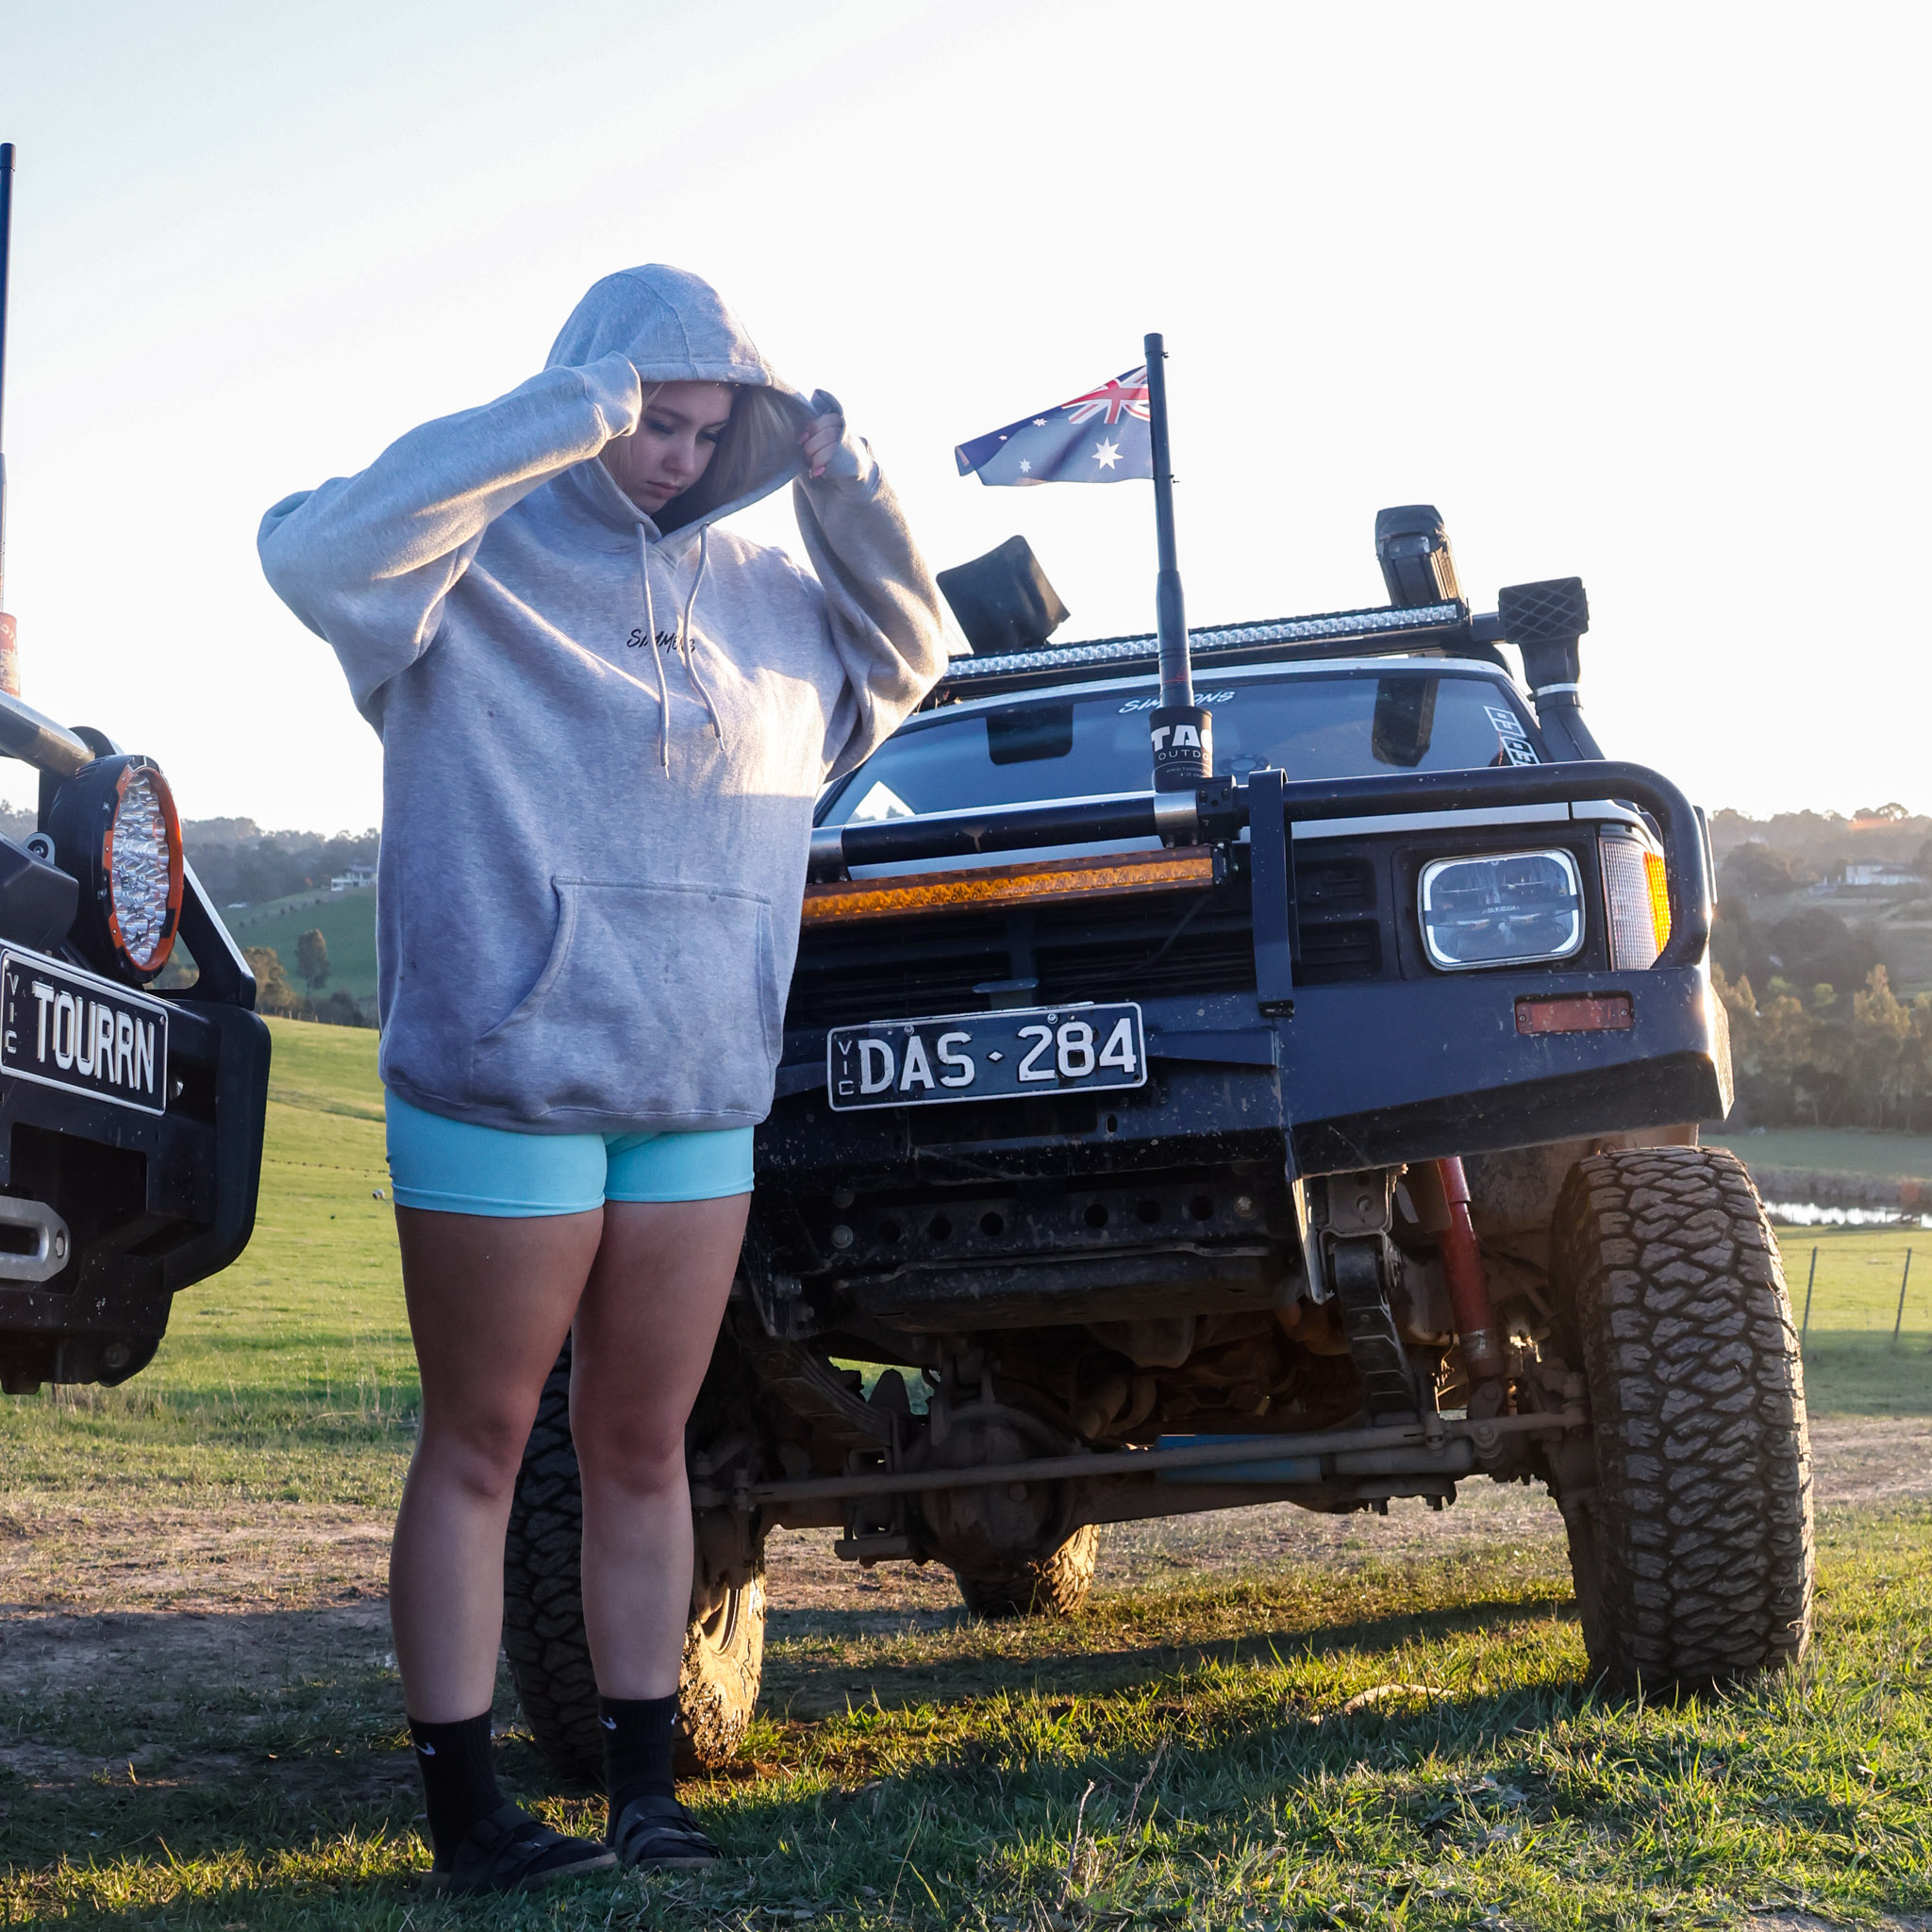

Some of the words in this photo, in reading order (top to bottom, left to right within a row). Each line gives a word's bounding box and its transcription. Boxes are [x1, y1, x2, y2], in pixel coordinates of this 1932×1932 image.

[31, 980, 155, 1094] TOURRN
[838, 1040, 855, 1096] VIC
[858, 1031, 975, 1095] DAS
[1017, 1017, 1138, 1082] 284
